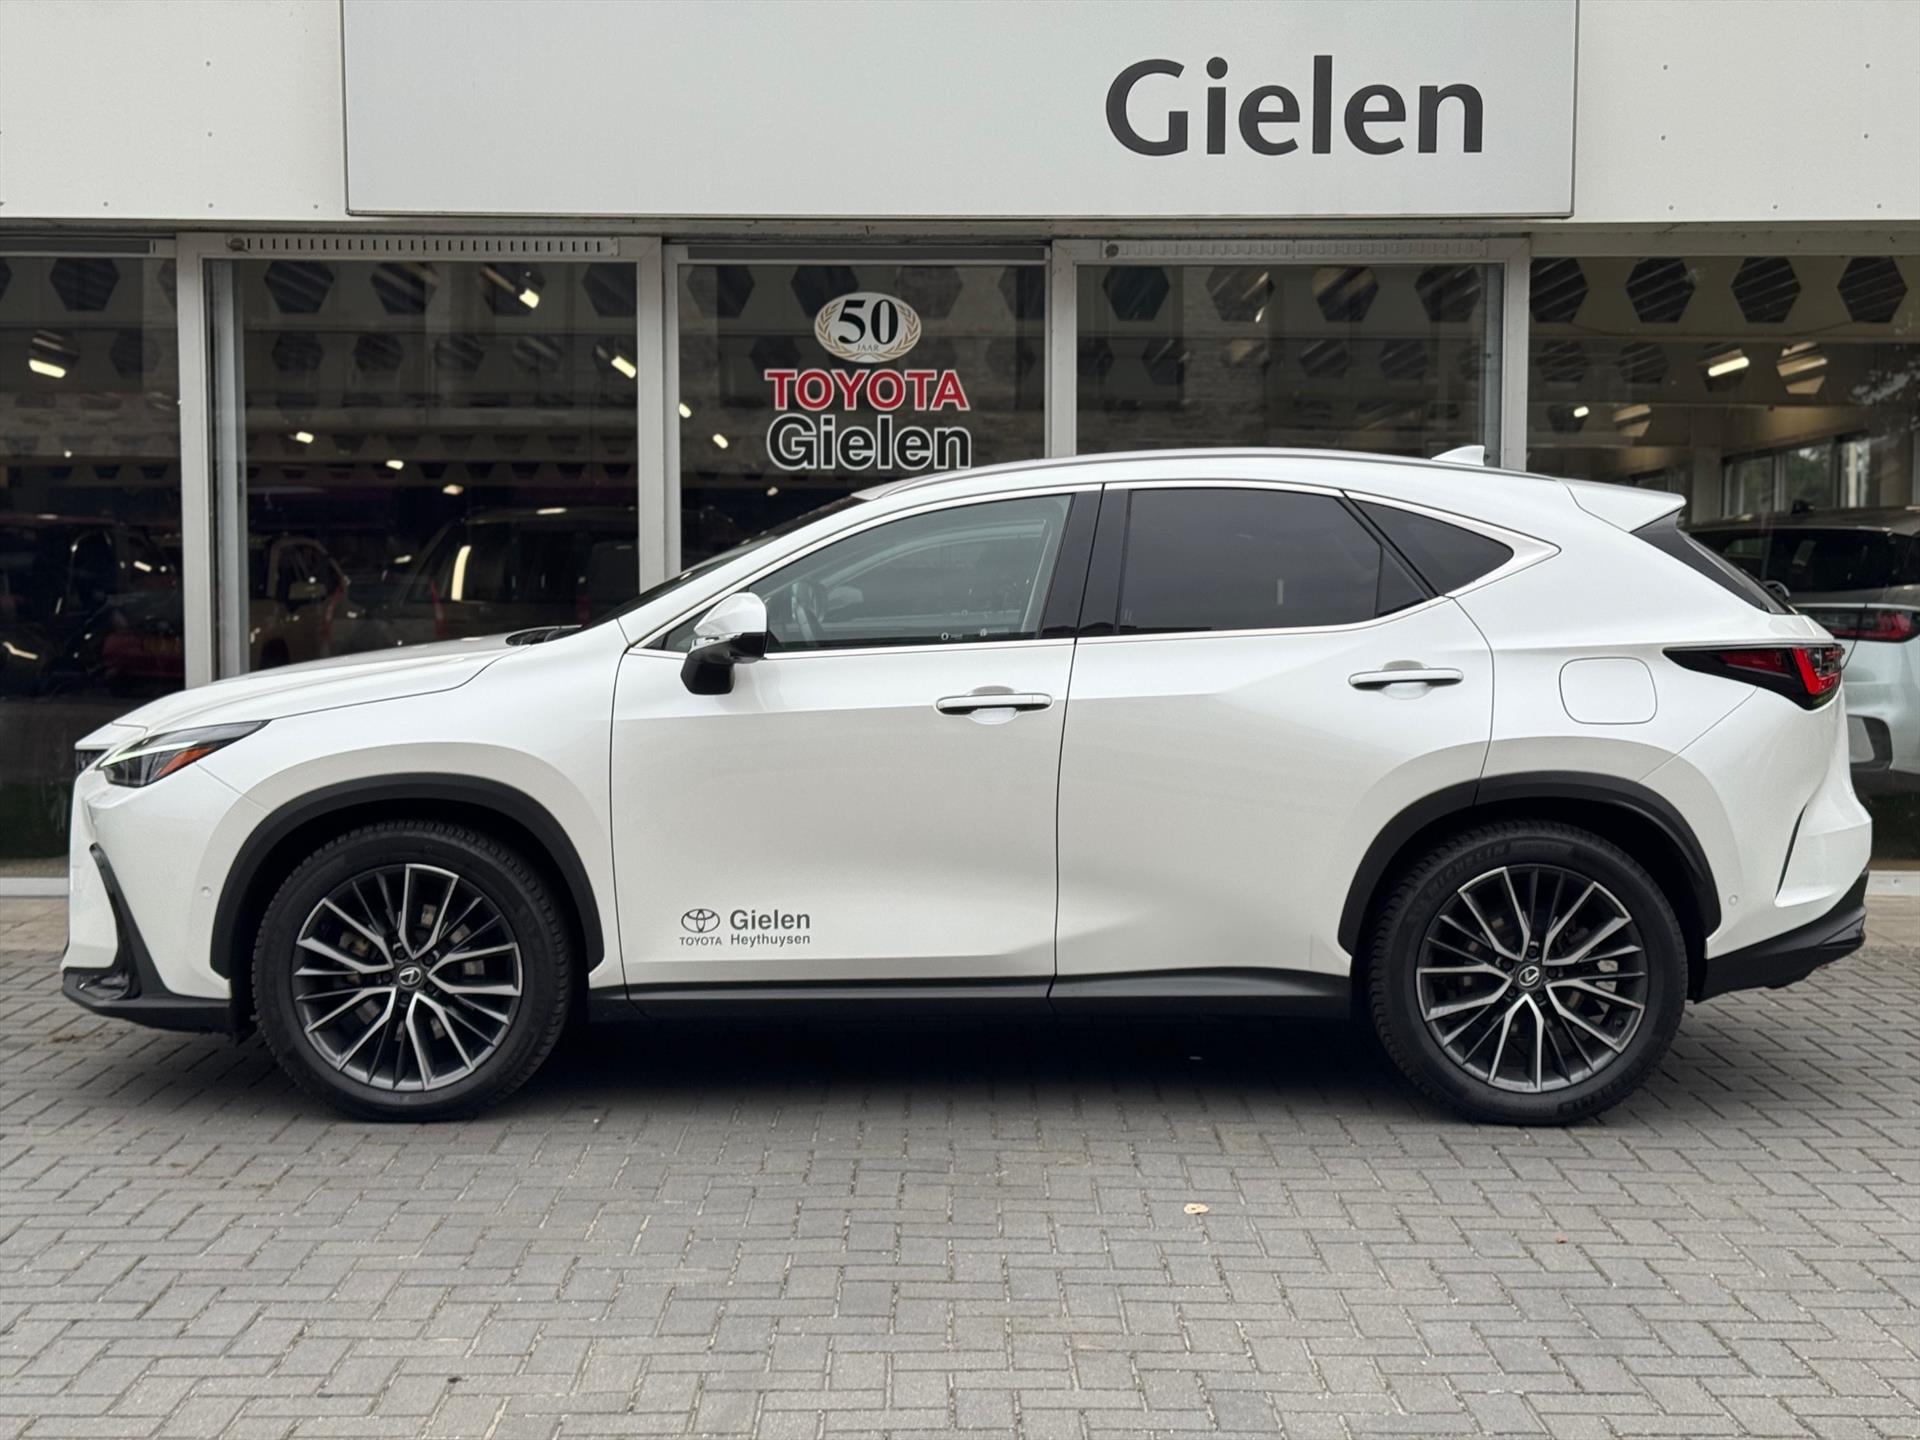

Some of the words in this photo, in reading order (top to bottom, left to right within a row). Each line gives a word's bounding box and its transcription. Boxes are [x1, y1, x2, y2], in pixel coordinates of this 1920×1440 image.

[1106, 55, 1483, 156] Gielen
[838, 299, 899, 345] 50
[856, 343, 880, 352] JAAR
[764, 368, 971, 411] TOYOTA
[766, 413, 972, 471] Gielen
[730, 909, 811, 930] Gielen
[679, 936, 722, 946] TOYOTA
[730, 933, 811, 947] Heythuysen
